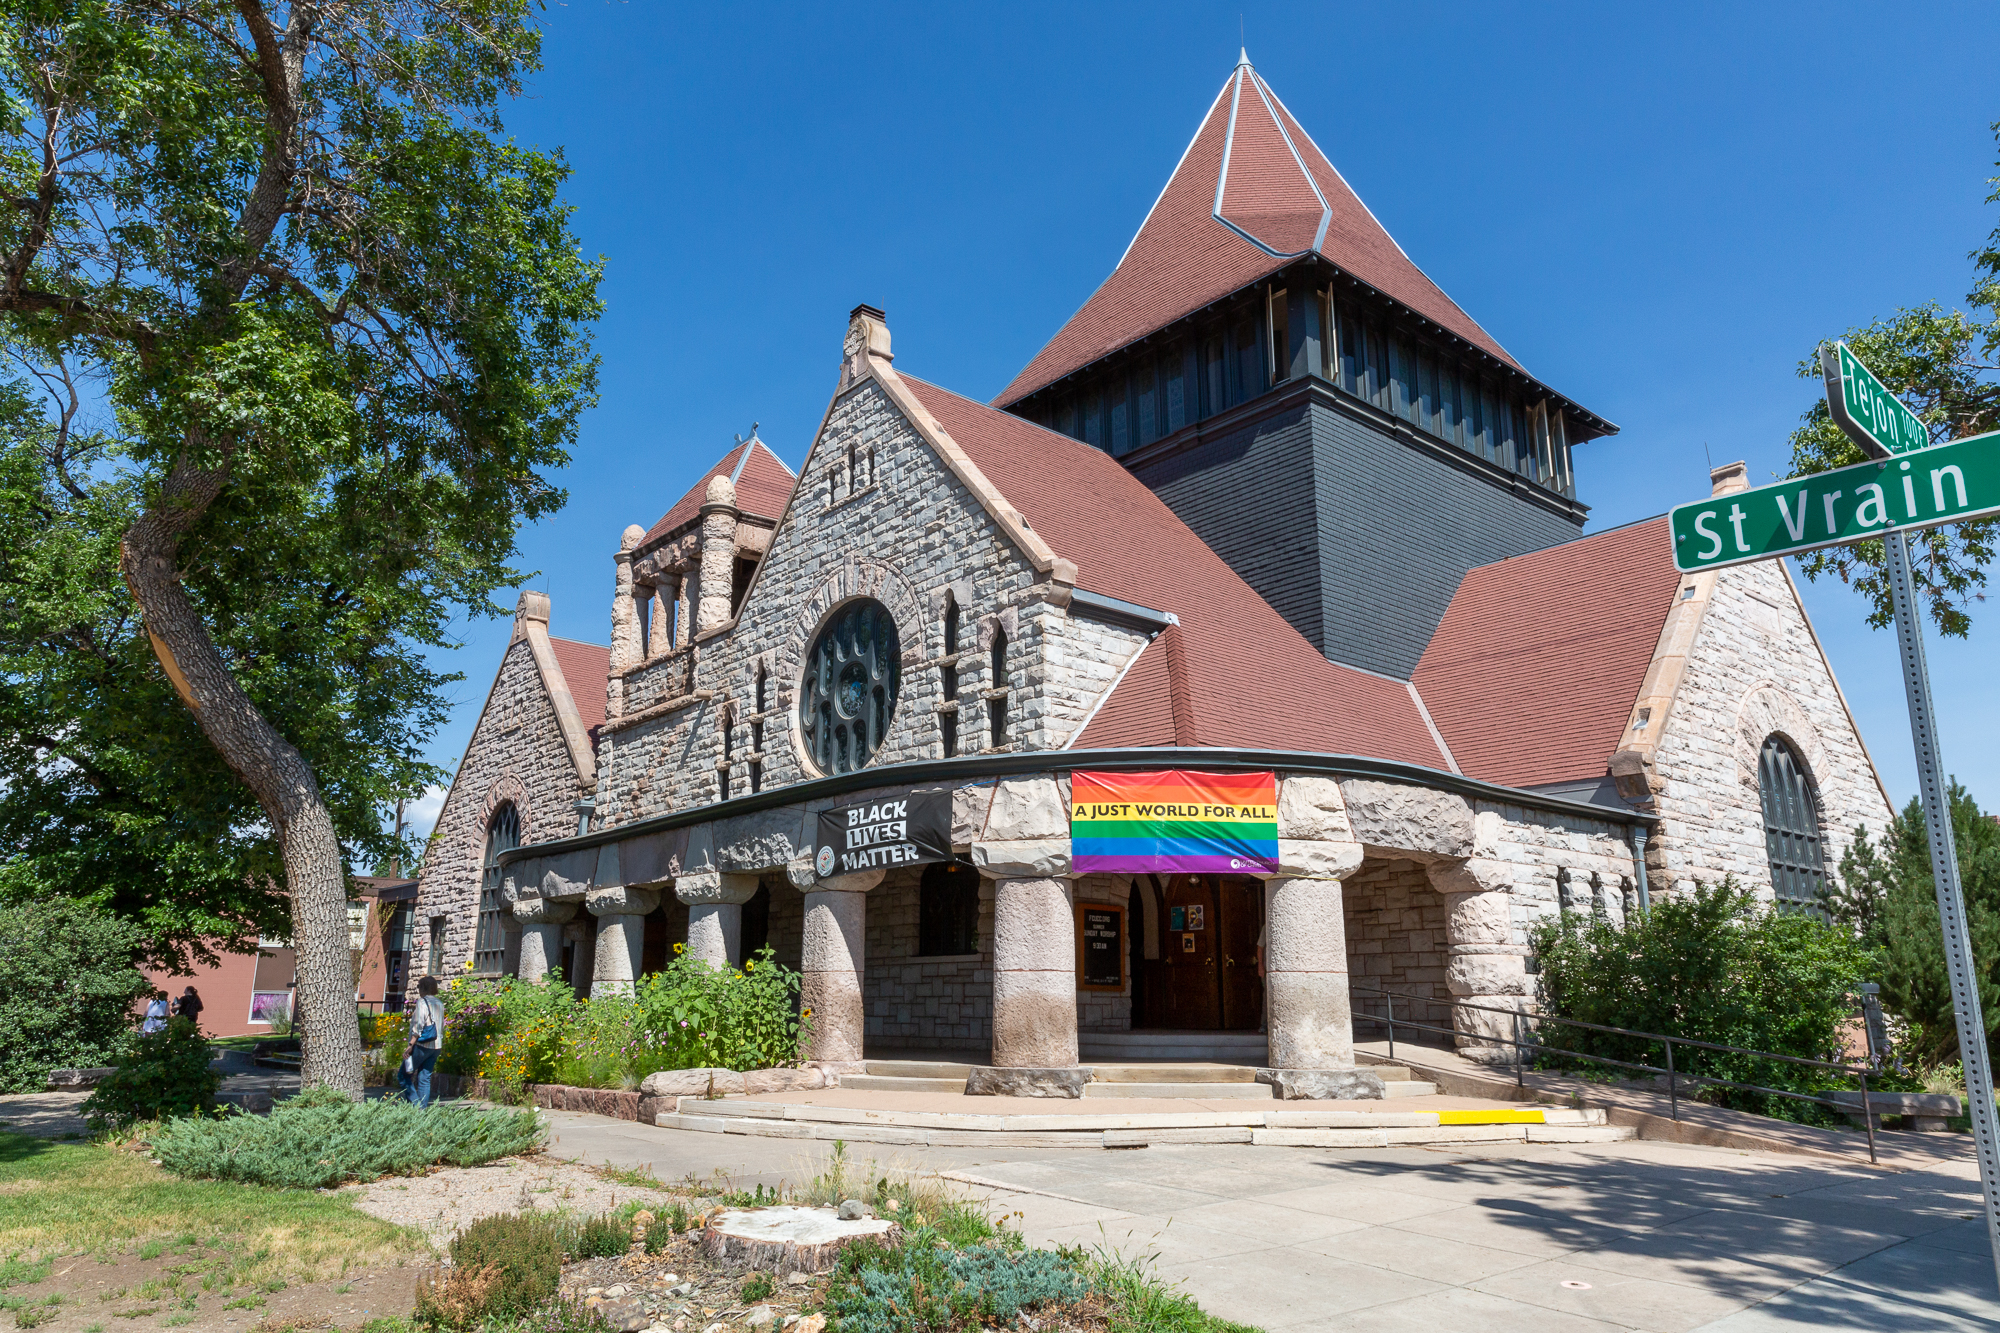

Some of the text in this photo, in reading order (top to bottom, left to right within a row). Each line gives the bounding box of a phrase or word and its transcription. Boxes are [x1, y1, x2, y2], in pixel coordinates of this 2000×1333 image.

[1847, 356, 1900, 445] Tejon
[1694, 460, 1969, 561] St Vrain
[847, 800, 907, 827] BLACK
[1074, 804, 1275, 820] A JUST WORLD FOR ALL.
[849, 822, 902, 847] LIVES
[841, 843, 919, 871] MATTER
